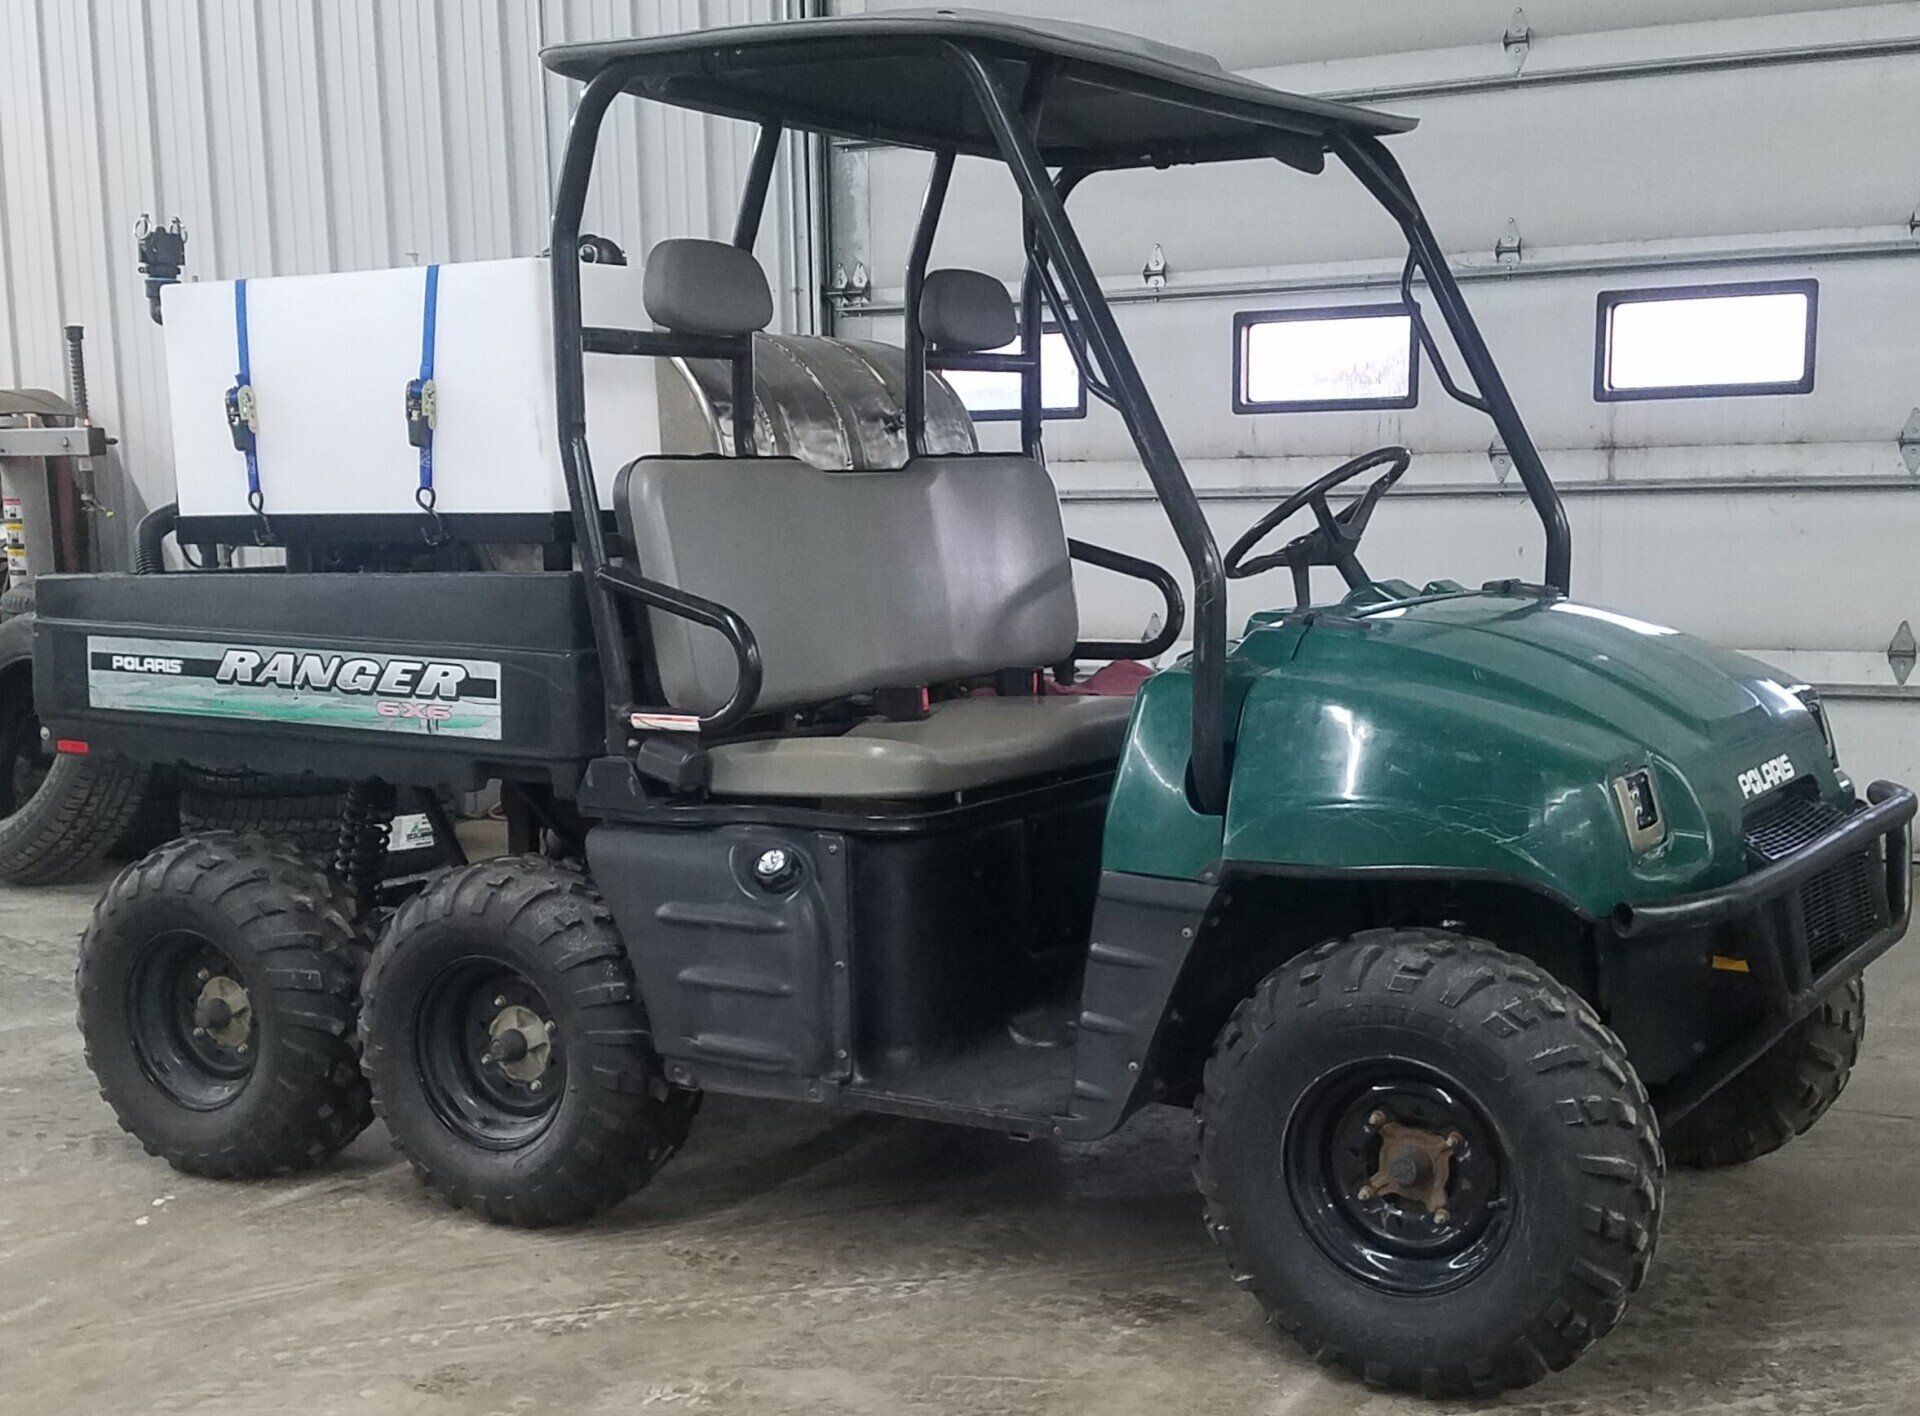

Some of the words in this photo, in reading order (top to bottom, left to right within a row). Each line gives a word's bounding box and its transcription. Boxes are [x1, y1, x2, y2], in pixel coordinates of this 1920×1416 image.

[112, 655, 183, 674] POLARIS
[214, 648, 469, 701] RANGER
[1737, 753, 1796, 800] POLARIS
